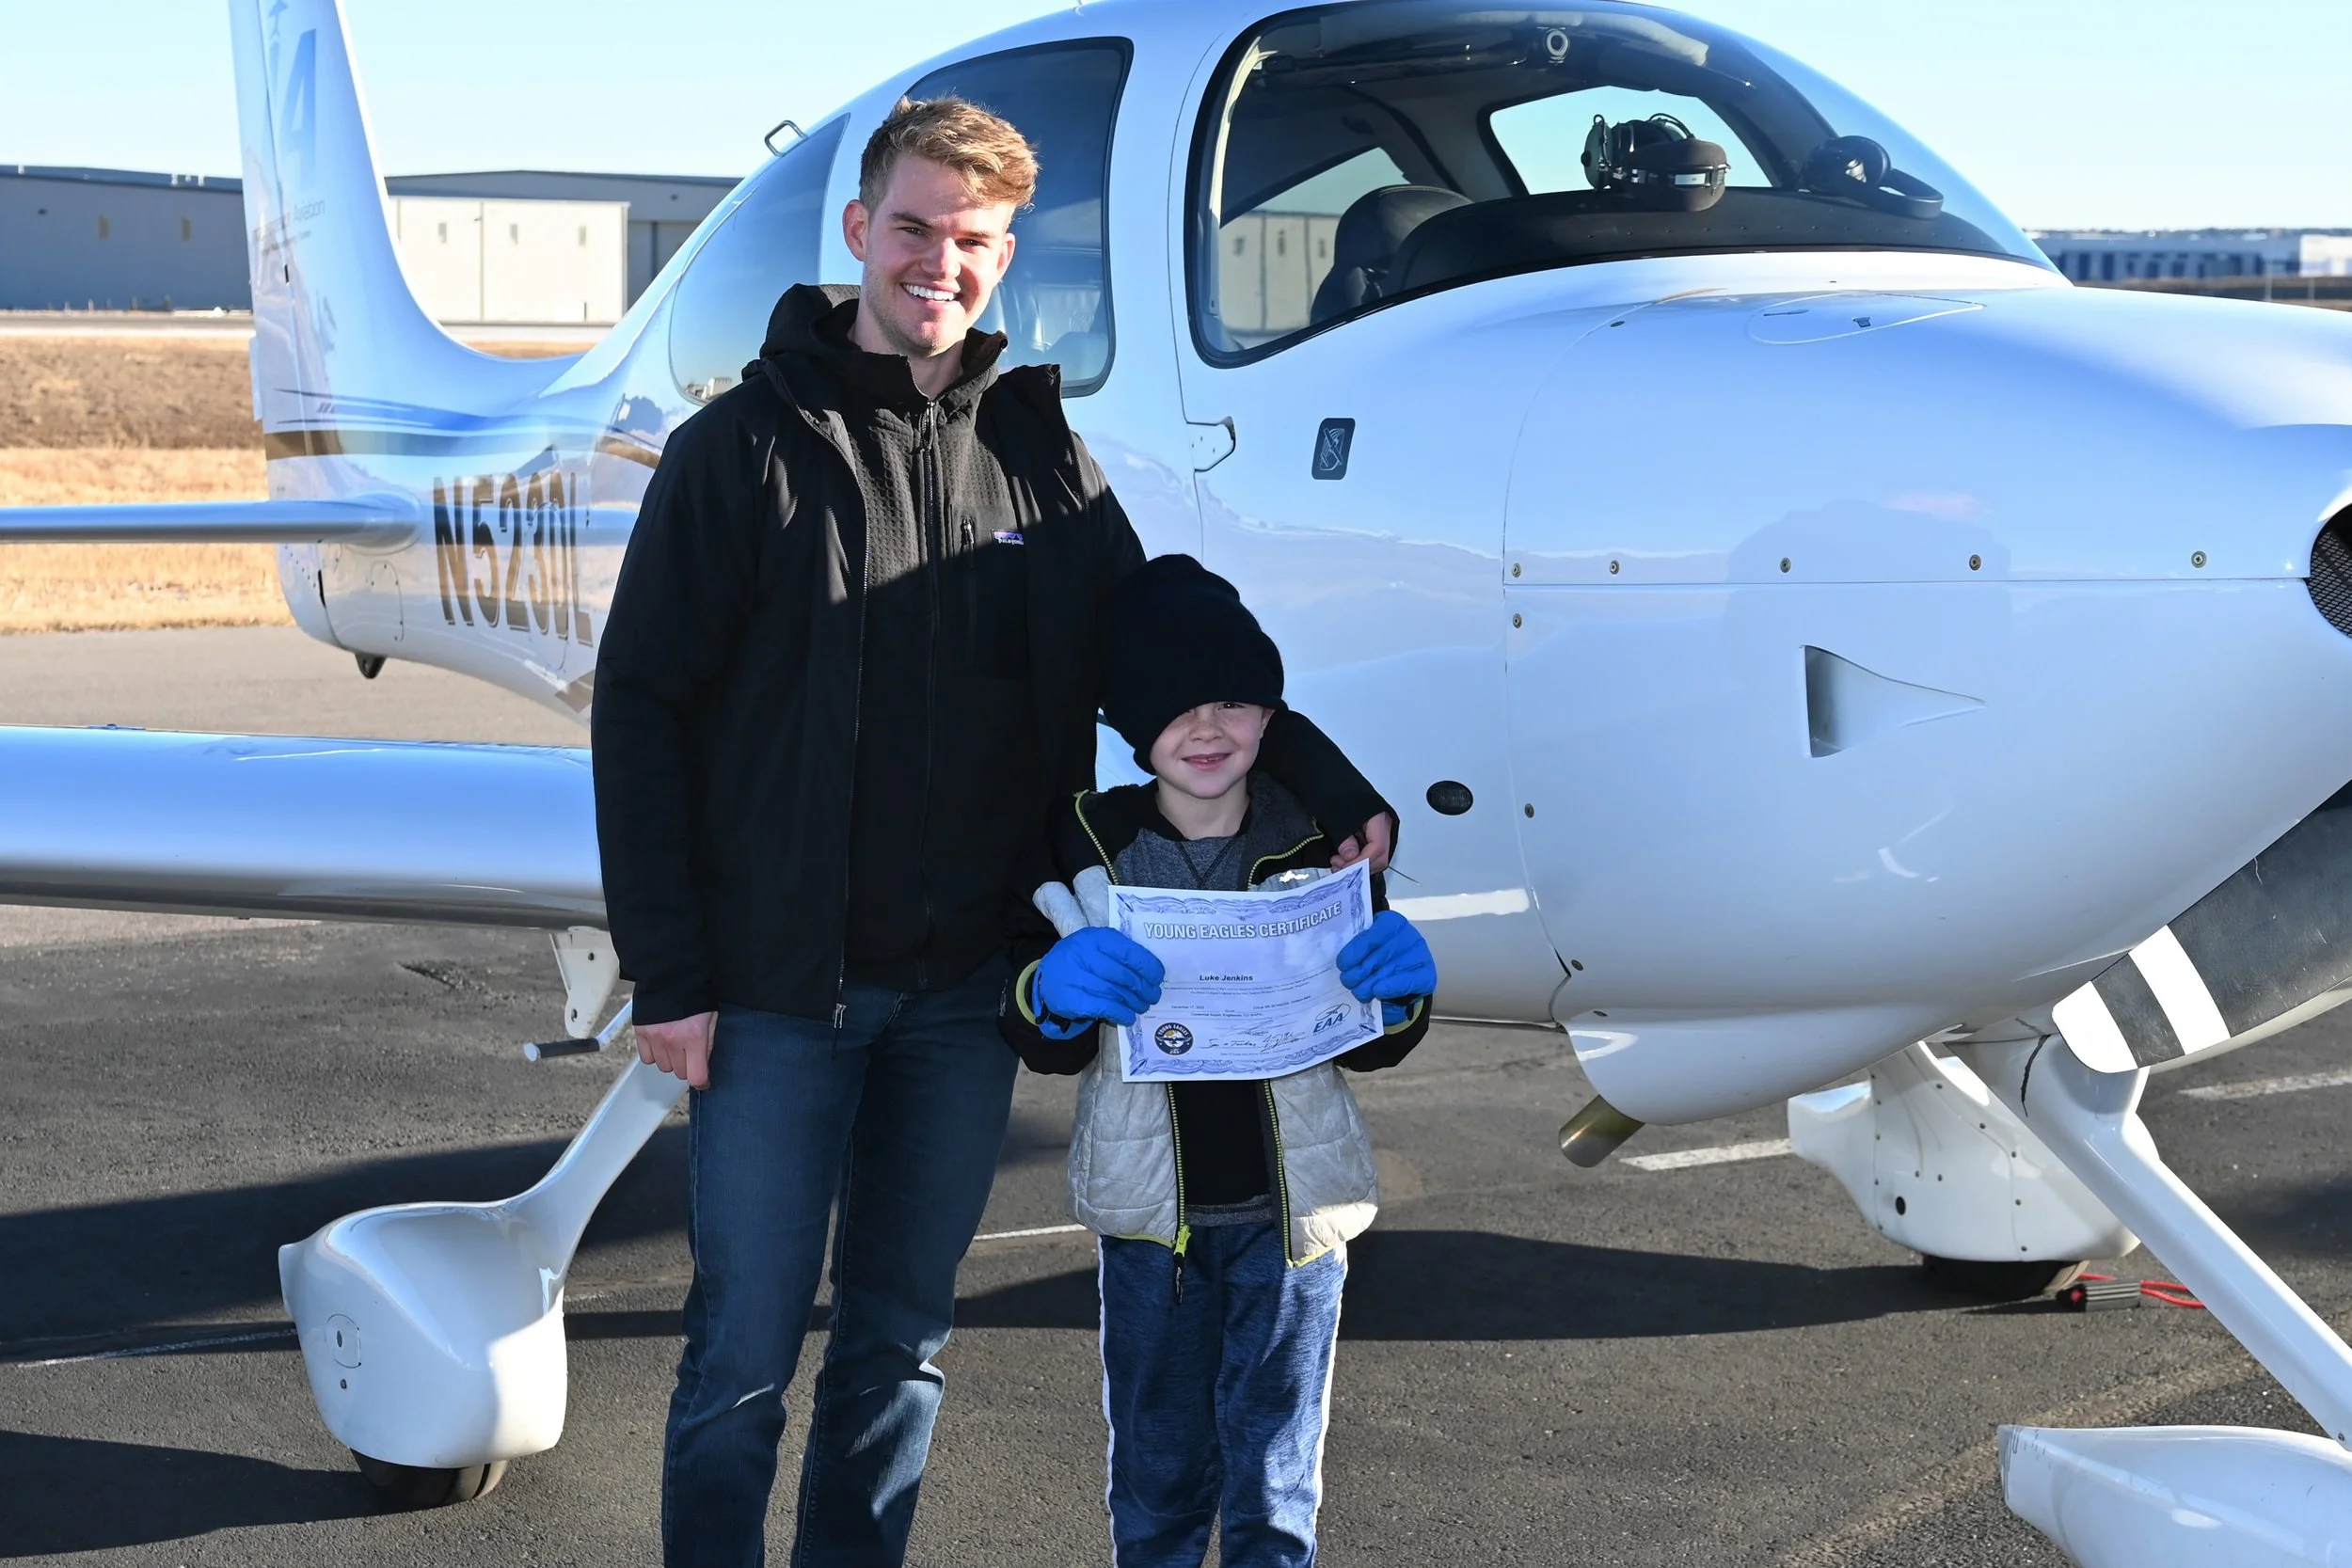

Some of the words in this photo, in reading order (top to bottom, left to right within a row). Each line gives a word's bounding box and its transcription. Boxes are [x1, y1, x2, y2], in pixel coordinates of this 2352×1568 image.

[1144, 923, 1197, 940] YOUNG
[1200, 924, 1256, 939] EAGLES
[1259, 901, 1343, 938] CERTIFICATE
[1313, 1012, 1345, 1034] EAA
